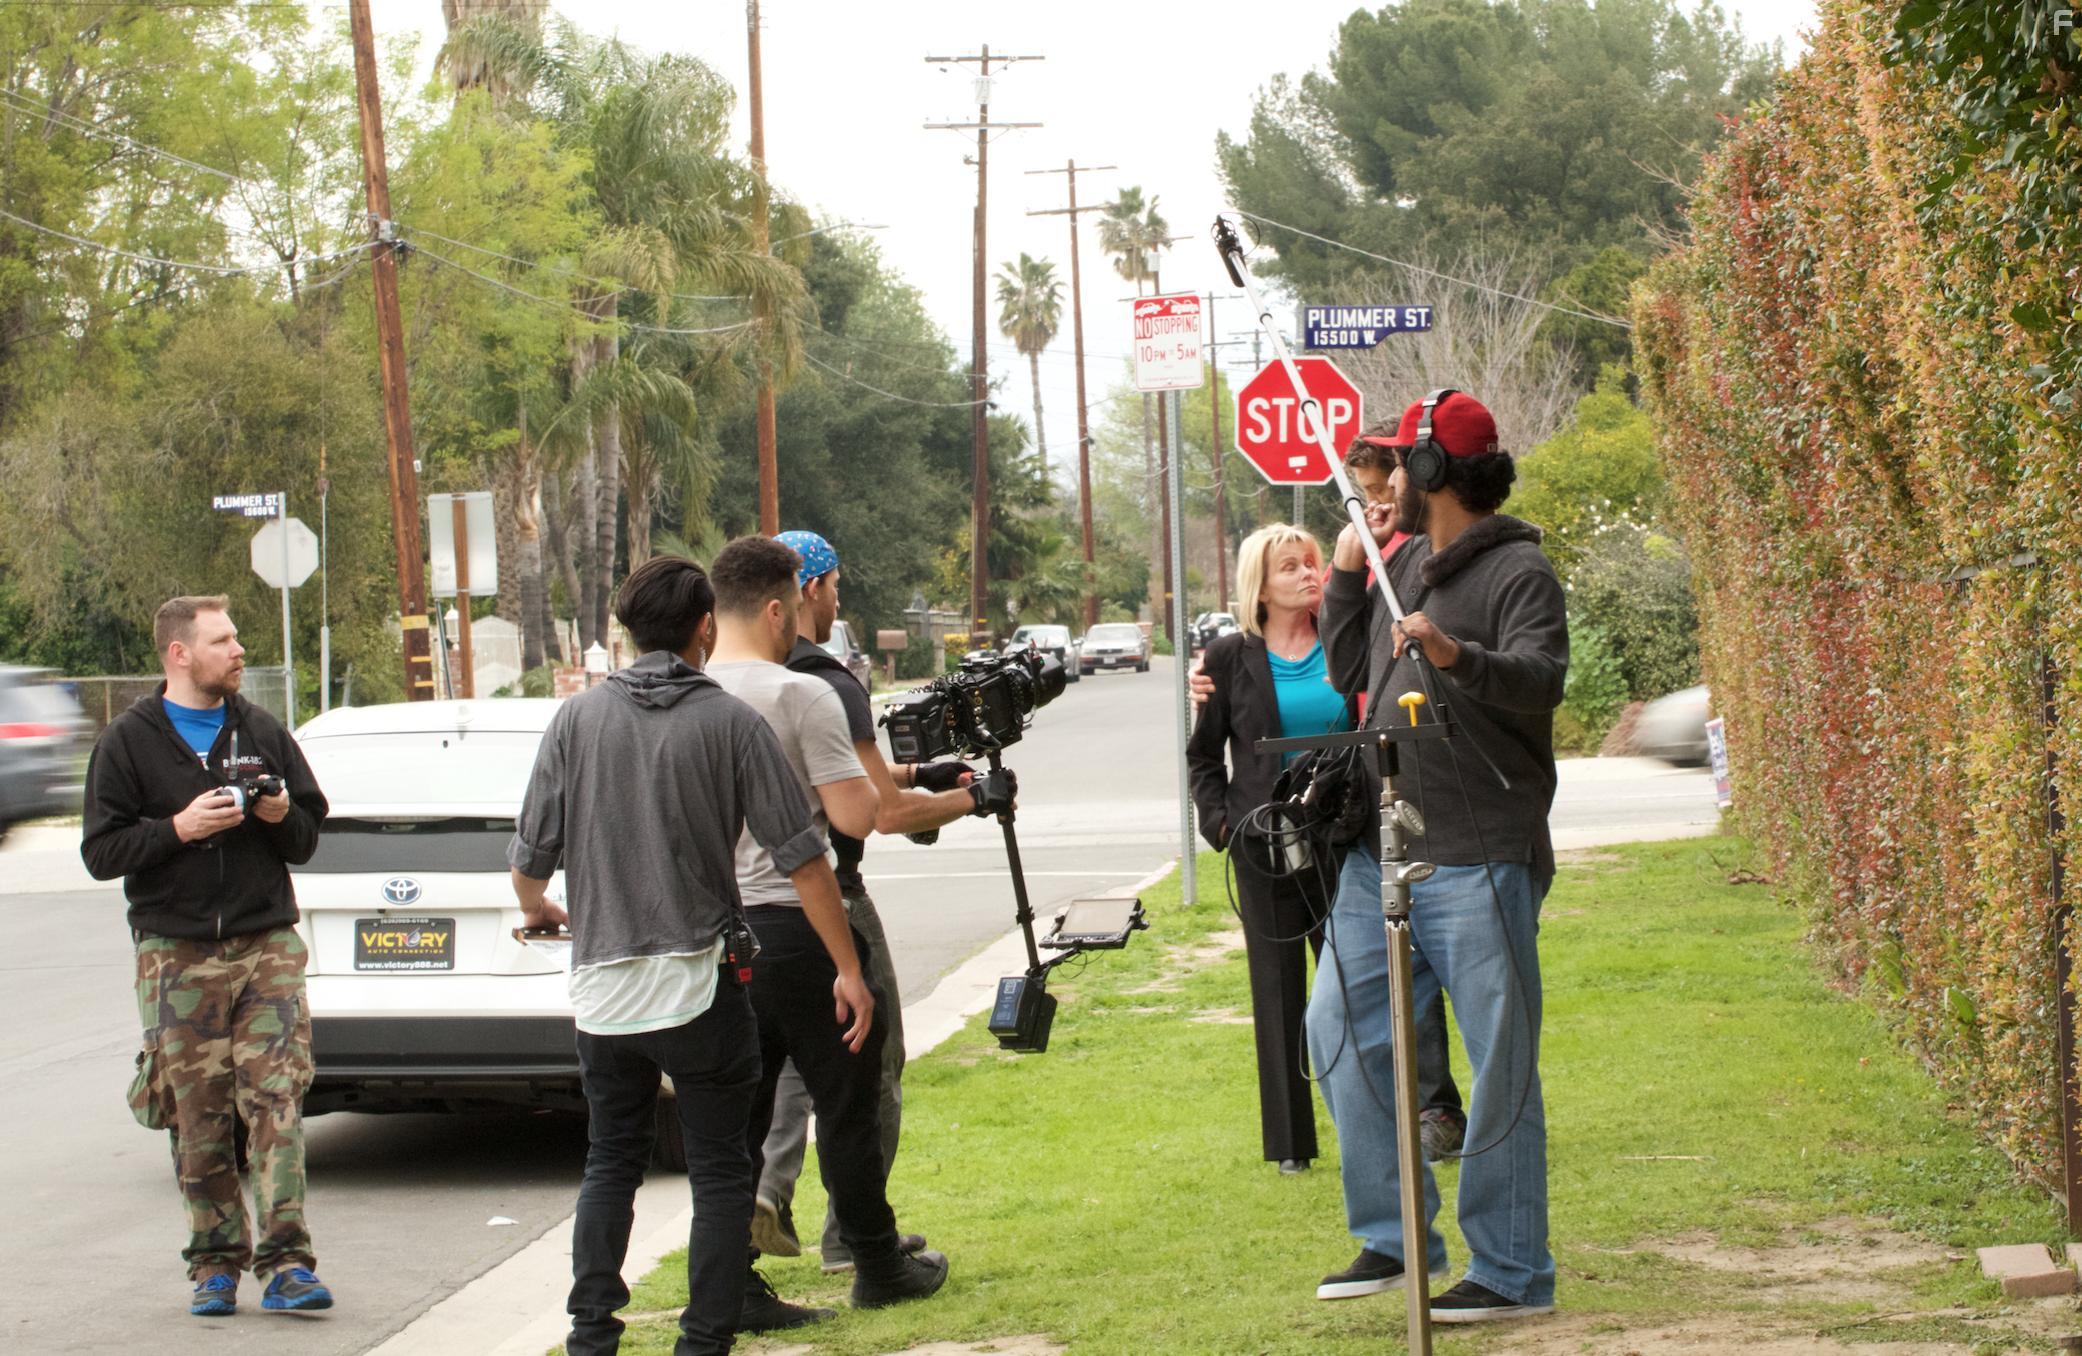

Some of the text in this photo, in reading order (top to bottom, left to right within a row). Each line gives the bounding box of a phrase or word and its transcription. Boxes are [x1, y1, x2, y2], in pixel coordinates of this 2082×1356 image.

[1136, 316, 1198, 338] NO STOPPING
[1308, 307, 1432, 328] PLUMMER ST.
[1314, 329, 1377, 346] 15500 W.
[1245, 396, 1353, 444] STOP
[213, 494, 278, 509] PLUMMER ST.
[361, 931, 448, 947] VICTORY
